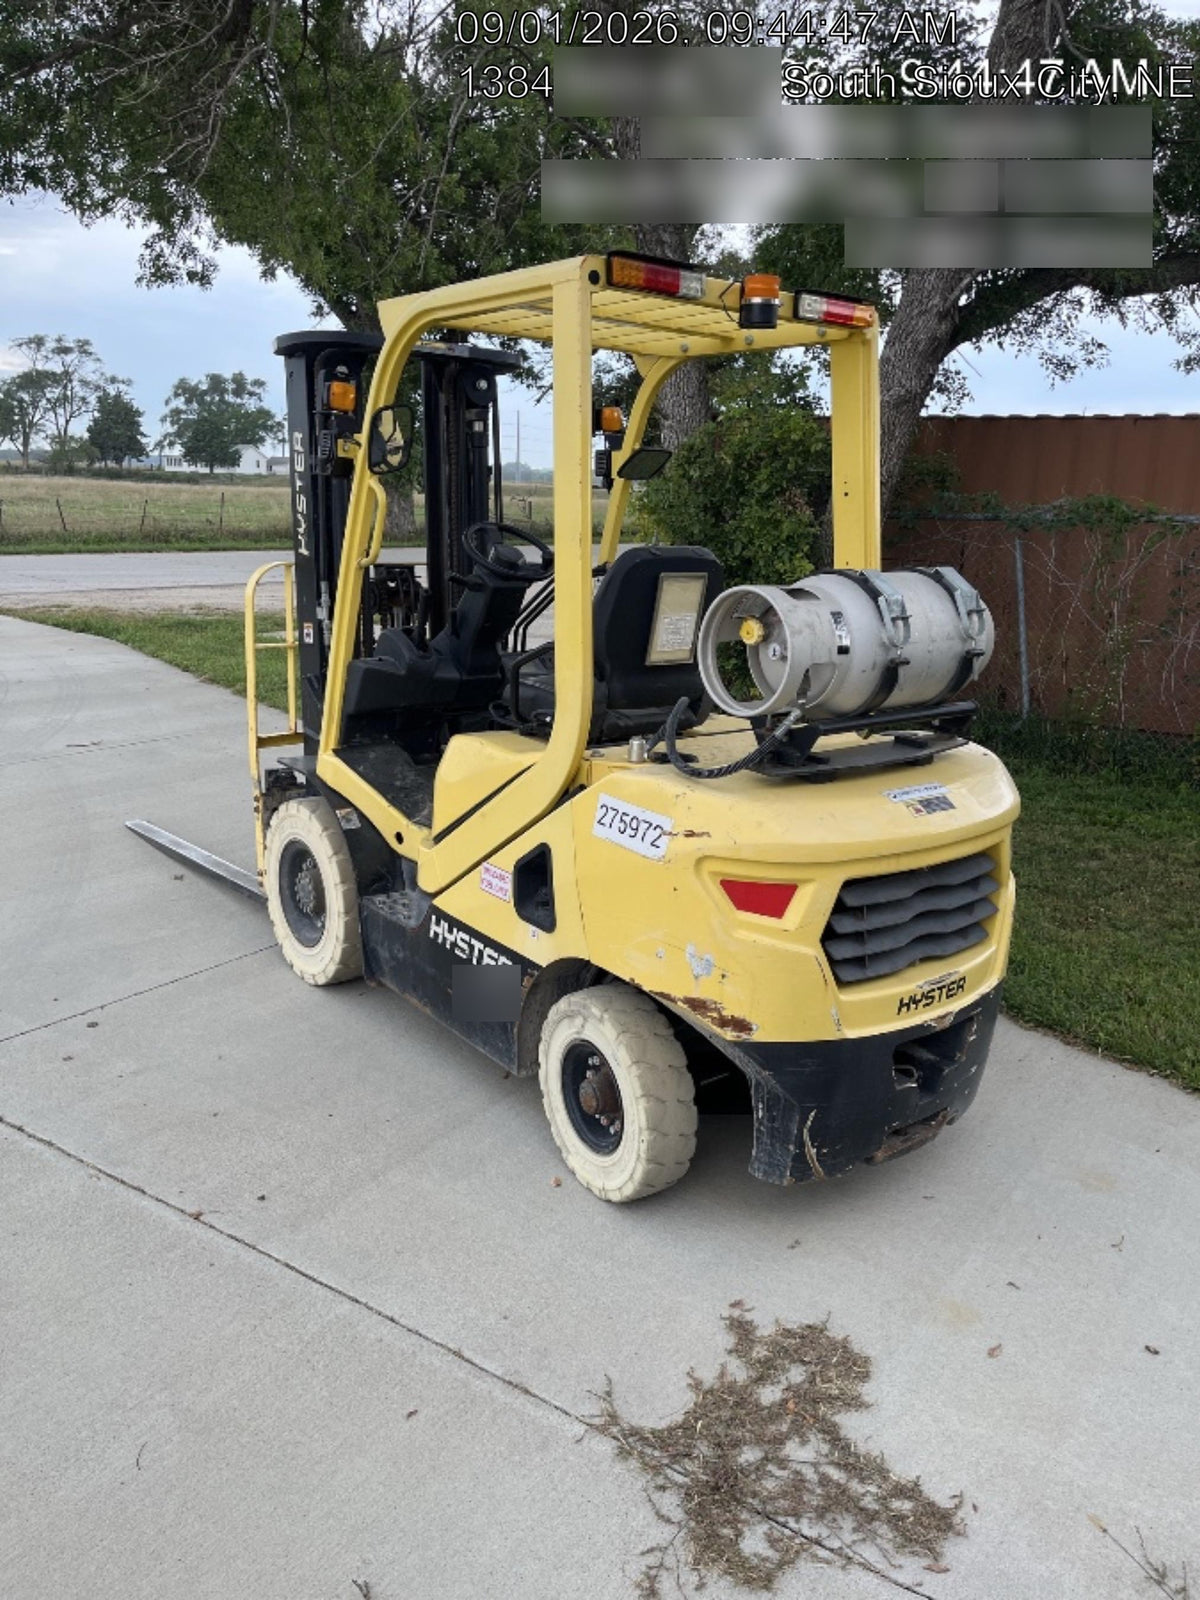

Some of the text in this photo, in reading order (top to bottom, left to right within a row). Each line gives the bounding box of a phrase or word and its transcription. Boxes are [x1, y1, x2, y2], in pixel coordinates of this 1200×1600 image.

[293, 431, 310, 557] HYSTER
[596, 803, 665, 849] 275972
[896, 976, 967, 1016] HYSTER
